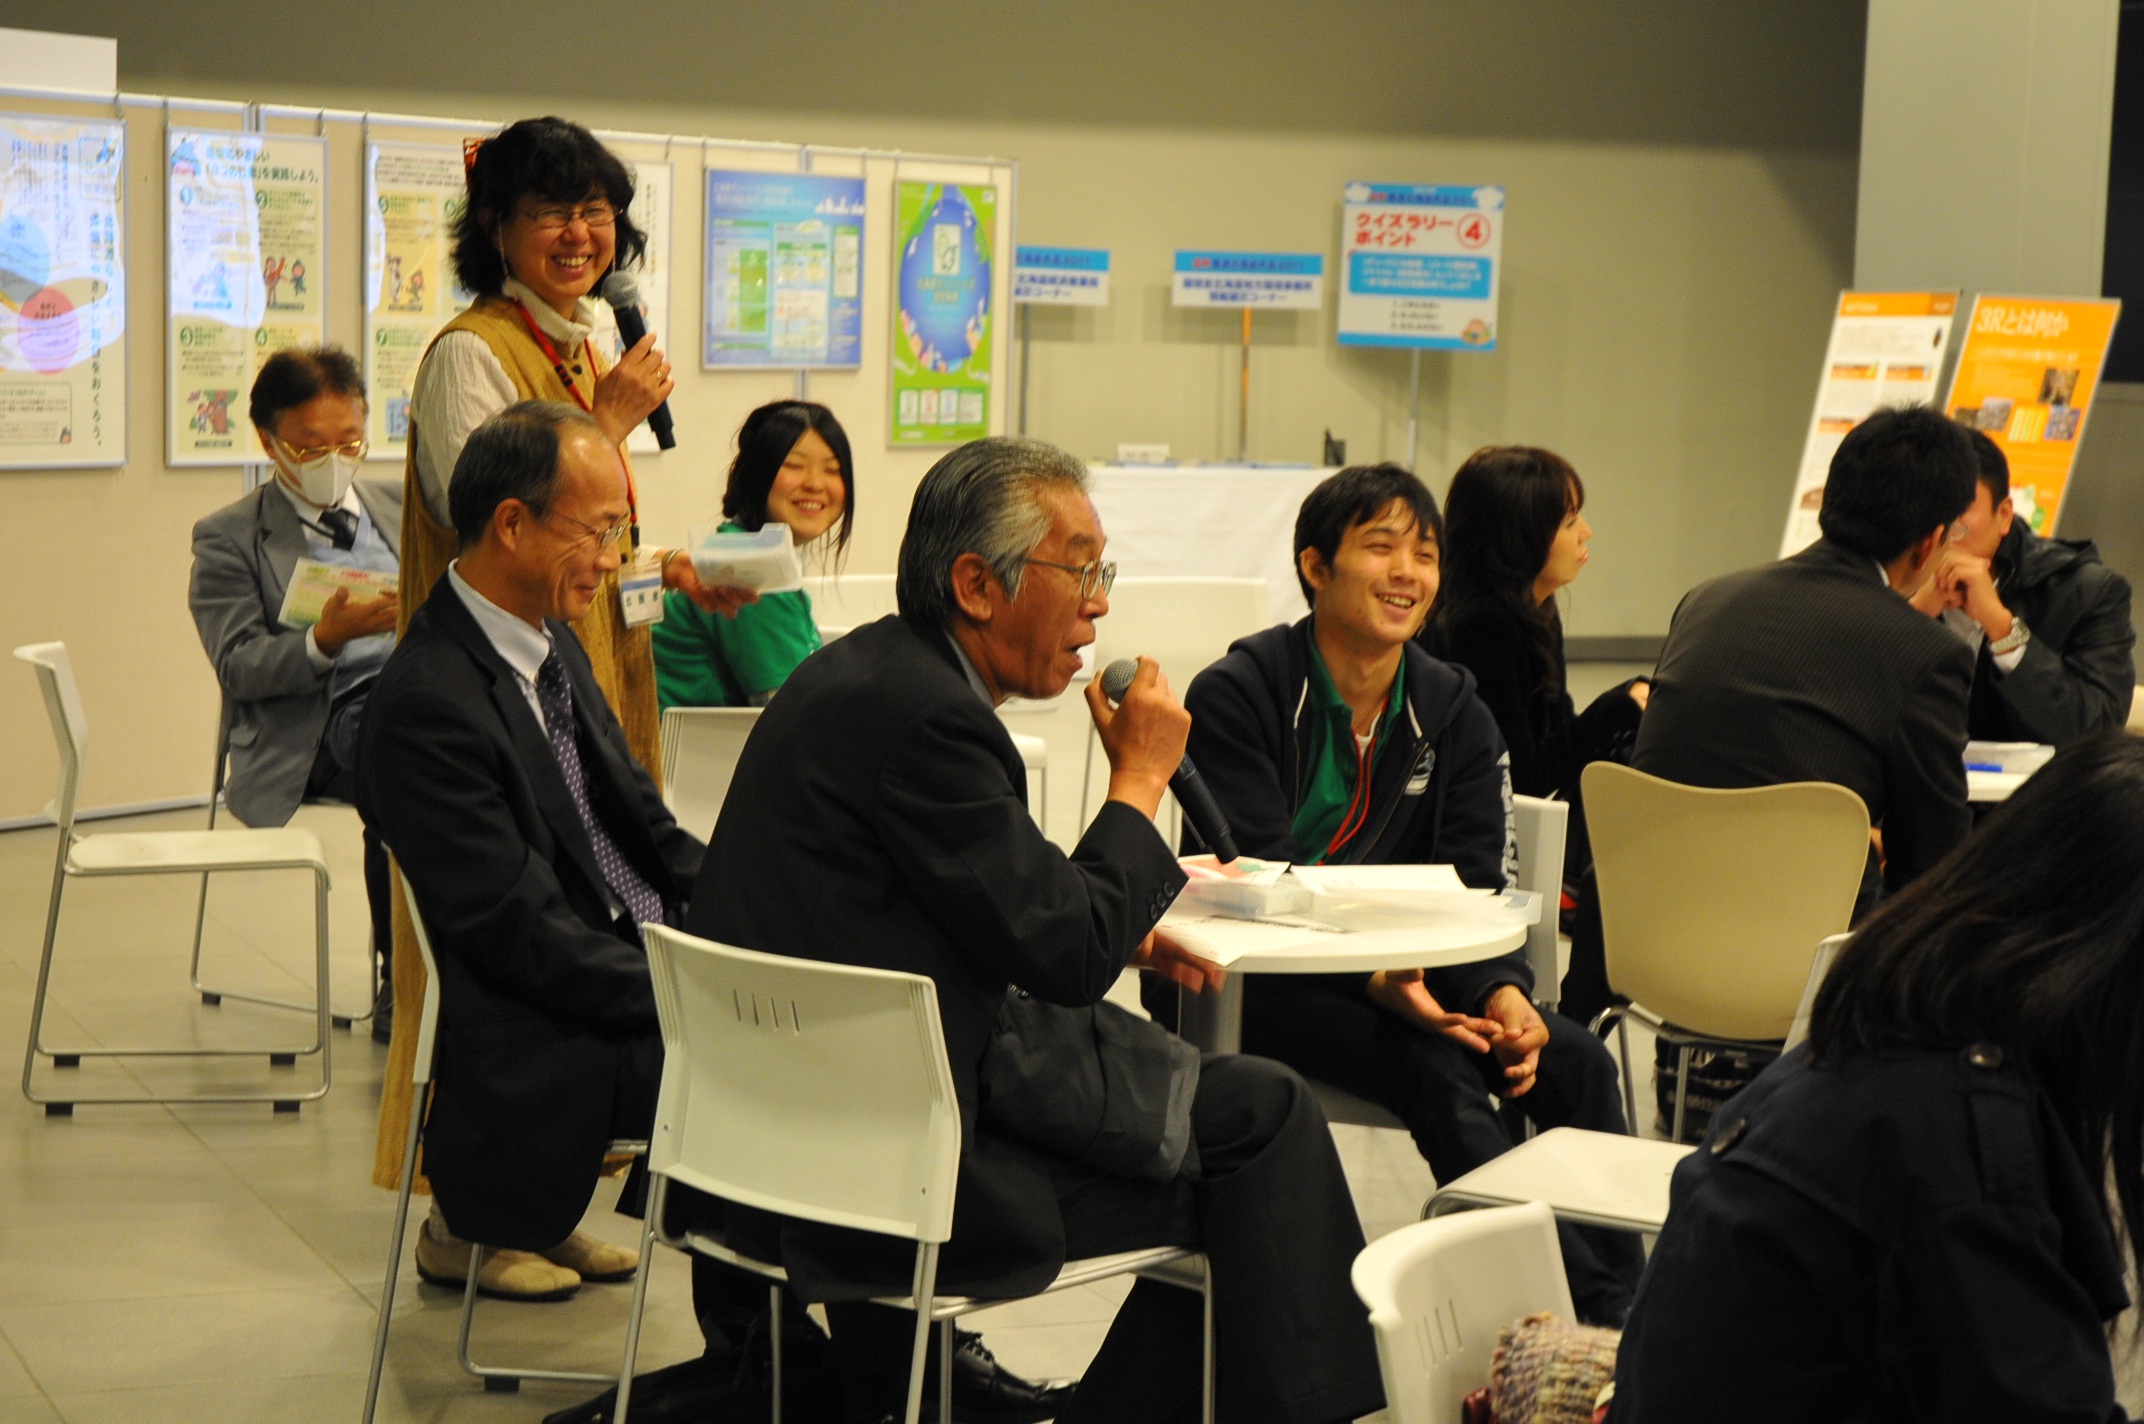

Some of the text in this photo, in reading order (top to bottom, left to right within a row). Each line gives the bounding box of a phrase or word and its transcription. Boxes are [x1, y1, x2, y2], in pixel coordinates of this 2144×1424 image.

[1357, 211, 1455, 231] クイズラリー
[1356, 230, 1415, 247] ポイント
[1976, 304, 2069, 337] 3Rとは何か
